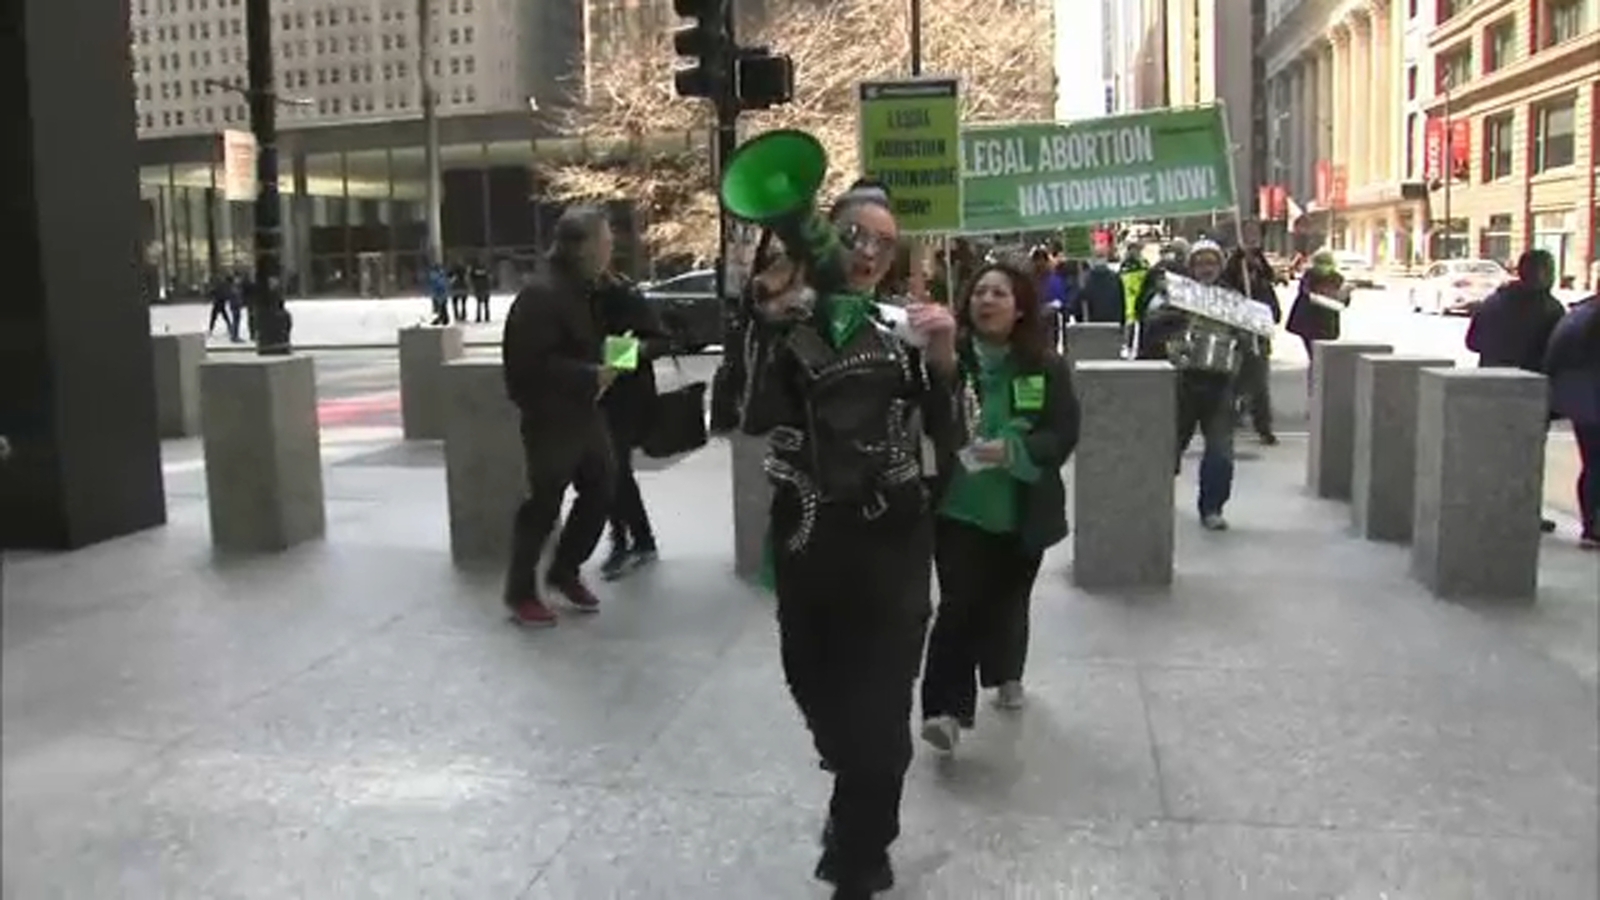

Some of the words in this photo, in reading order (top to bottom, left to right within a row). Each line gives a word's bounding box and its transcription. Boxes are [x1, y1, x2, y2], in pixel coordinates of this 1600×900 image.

[887, 108, 931, 128] LEGAL
[874, 138, 947, 159] ABORTION
[961, 140, 1032, 178] LEGAL
[1038, 126, 1153, 171] ABORTION
[1019, 173, 1155, 216] NATIONWIDE
[1158, 167, 1218, 202] NOW!
